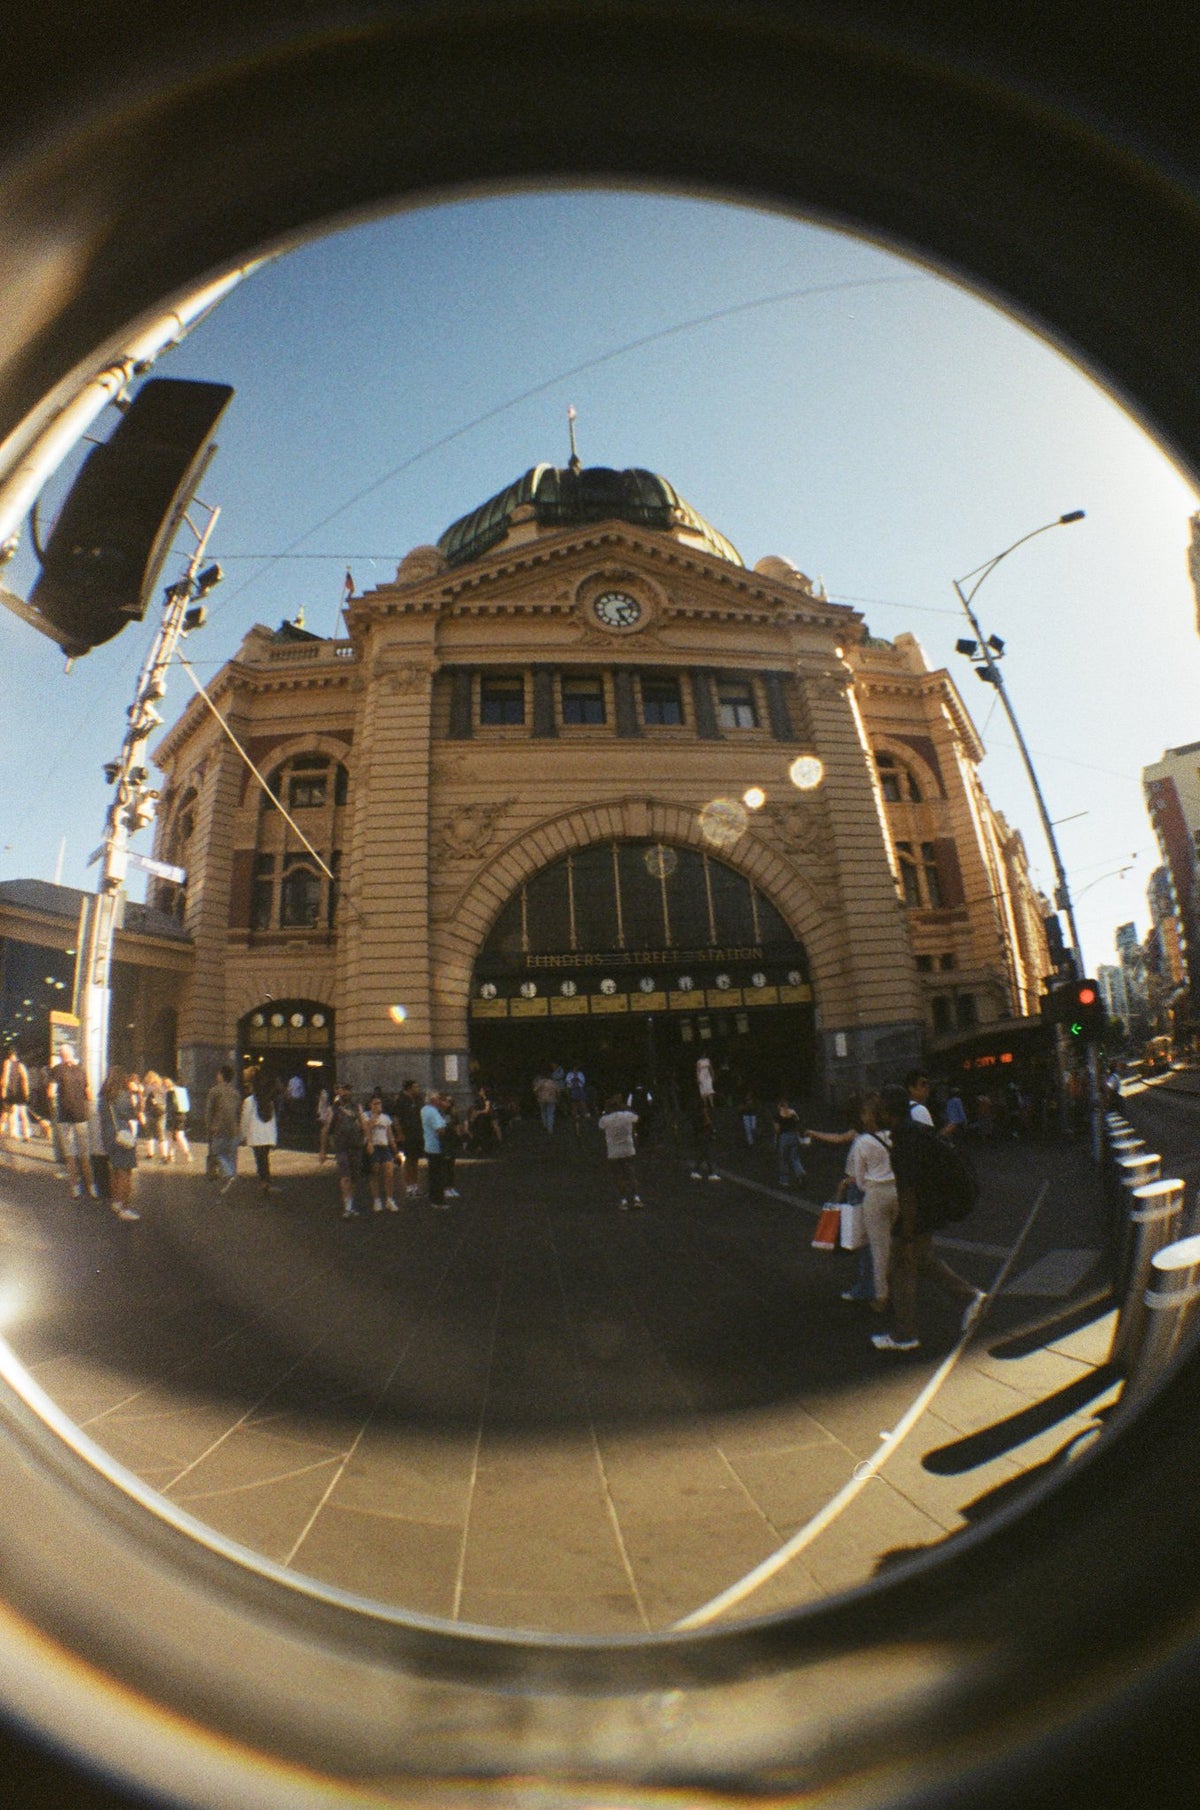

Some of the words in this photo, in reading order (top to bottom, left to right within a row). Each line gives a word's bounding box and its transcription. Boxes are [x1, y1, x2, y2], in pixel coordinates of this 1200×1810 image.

[526, 953, 603, 968] FLINDERS
[623, 950, 680, 964] STREET
[697, 947, 763, 961] STATION
